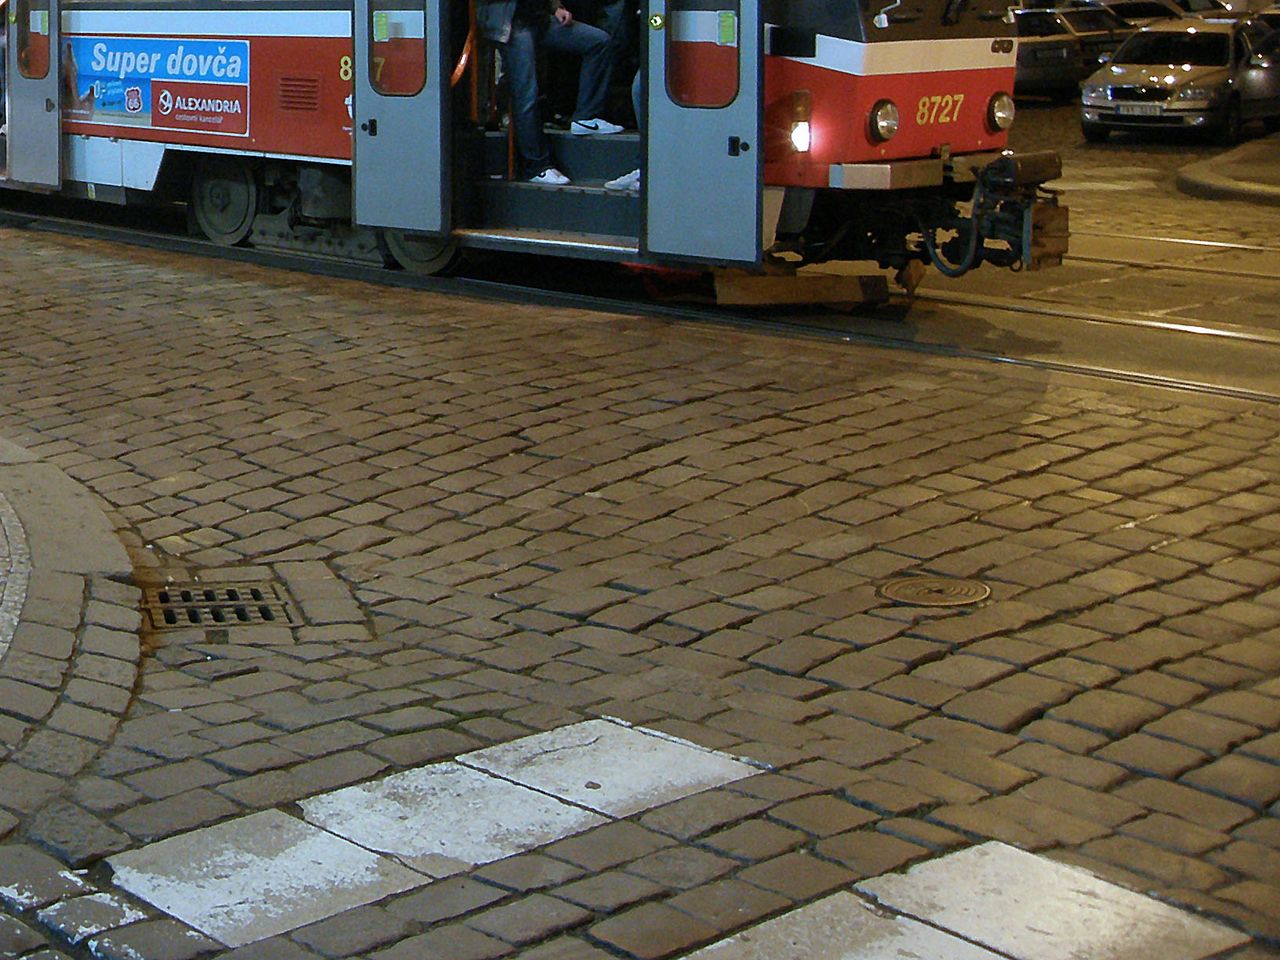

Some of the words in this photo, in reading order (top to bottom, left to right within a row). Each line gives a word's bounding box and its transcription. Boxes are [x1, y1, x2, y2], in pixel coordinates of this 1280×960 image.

[91, 42, 161, 79] Super
[166, 45, 242, 78] dovča
[174, 96, 242, 114] ALEXANDRIA
[915, 94, 965, 126] 8727
